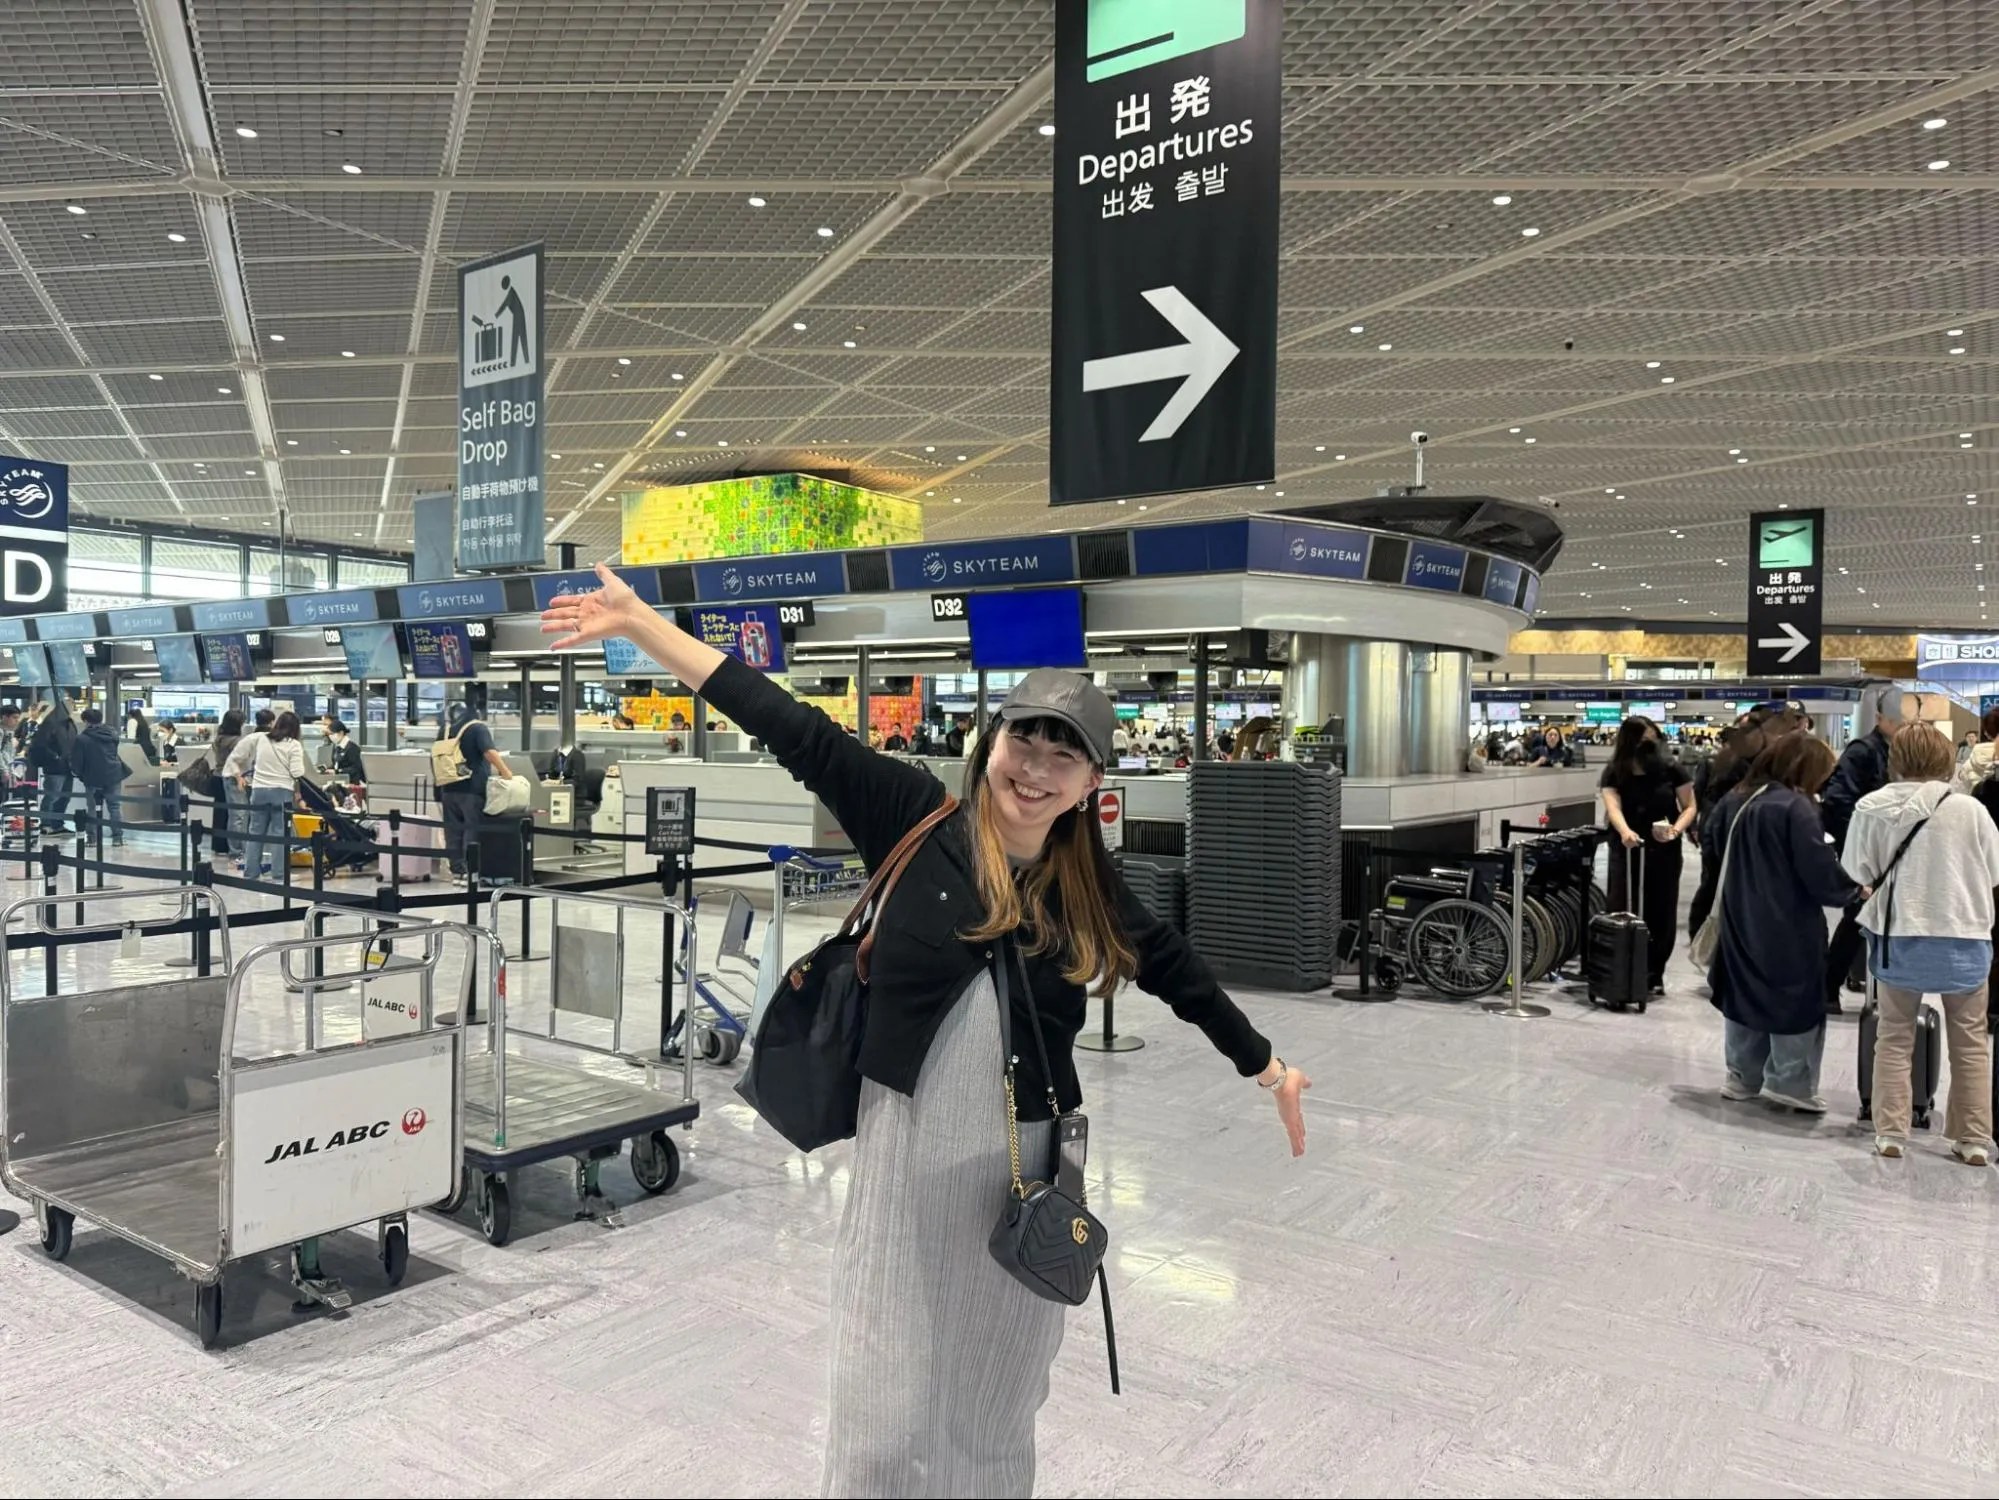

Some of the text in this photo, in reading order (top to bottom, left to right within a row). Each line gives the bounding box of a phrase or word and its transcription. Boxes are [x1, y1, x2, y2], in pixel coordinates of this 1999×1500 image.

[1078, 117, 1254, 185] Departures
[1101, 162, 1230, 220] 出发 출발
[462, 399, 537, 433] Self Bag
[462, 439, 507, 466] Drop
[462, 476, 539, 501] 自動手荷物預け機
[1310, 546, 1361, 563] SKYTEAM
[953, 555, 1039, 574] SKYTEAM
[1426, 561, 1461, 577] SKYTEAM
[4, 550, 53, 603] D
[747, 571, 817, 588] SKYTEAM
[1756, 584, 1815, 595] Departures
[318, 603, 359, 615] SKYTEAM
[435, 593, 485, 608] SKYTEAM
[933, 598, 963, 616] D32
[218, 610, 254, 622] SKYTEAM
[780, 607, 805, 623] D31
[466, 623, 486, 637] D29
[1960, 645, 1999, 659] SHO
[367, 997, 383, 1009] JAL
[384, 1001, 405, 1013] ABC
[264, 1120, 390, 1164] JAL ABC
